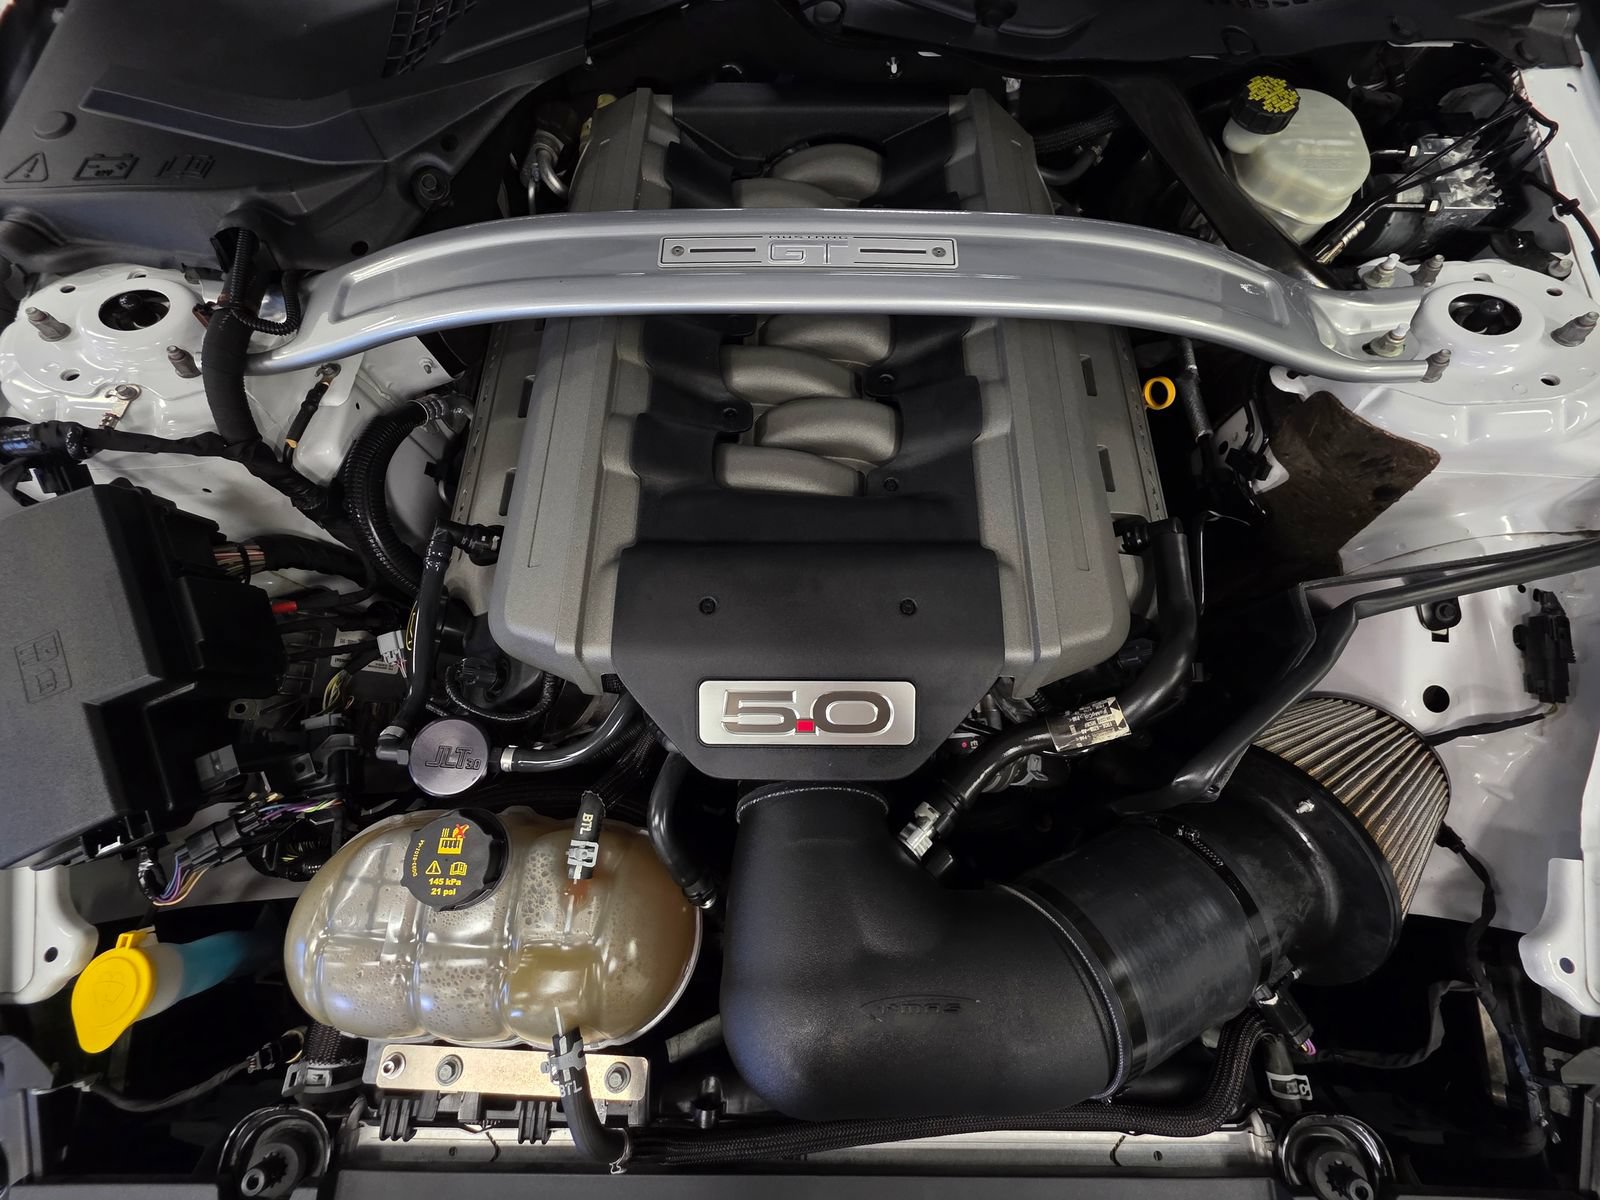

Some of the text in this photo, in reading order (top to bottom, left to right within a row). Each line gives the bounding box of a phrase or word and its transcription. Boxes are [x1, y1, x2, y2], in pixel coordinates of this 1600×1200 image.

[767, 241, 849, 265] GT
[721, 689, 895, 736] 5.0
[424, 745, 472, 769] JLT
[579, 812, 594, 835] BTL
[428, 878, 462, 886] 145 kPa
[430, 887, 456, 897] 21 psi
